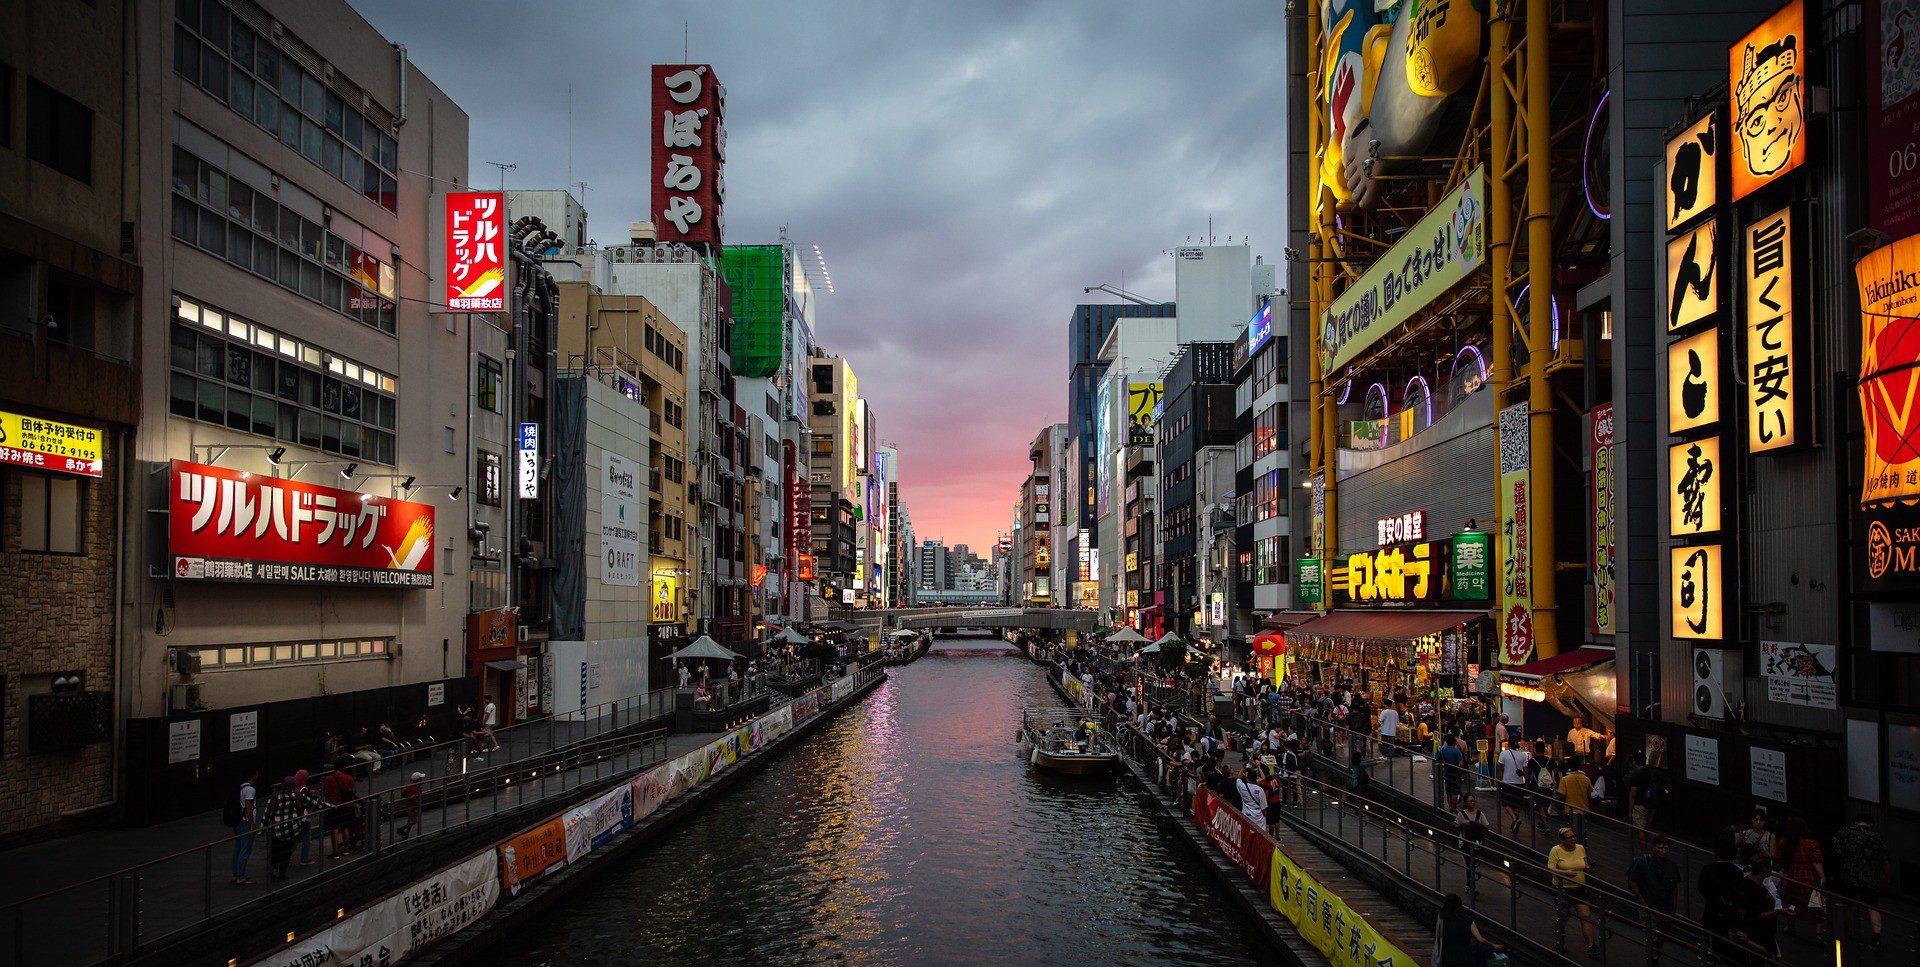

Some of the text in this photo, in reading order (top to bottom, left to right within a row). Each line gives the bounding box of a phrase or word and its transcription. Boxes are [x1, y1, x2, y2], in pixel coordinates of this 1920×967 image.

[664, 65, 709, 235] づぼらや
[452, 210, 472, 281] ドラッグ
[474, 198, 498, 263] ツルハ
[1752, 216, 1790, 444] 旨くて安い
[21, 418, 95, 443] 団体予約受付中
[524, 424, 536, 449] 焼肉
[180, 470, 388, 549] ツルハドラッグ
[1377, 509, 1423, 546] 驚安の殿堂
[1456, 541, 1484, 570] 薬
[1504, 516, 1516, 597] オープン
[290, 565, 316, 581] SALE
[372, 570, 410, 585] WELCOME
[1510, 612, 1528, 634] すぐ
[1510, 634, 1527, 655] そこ
